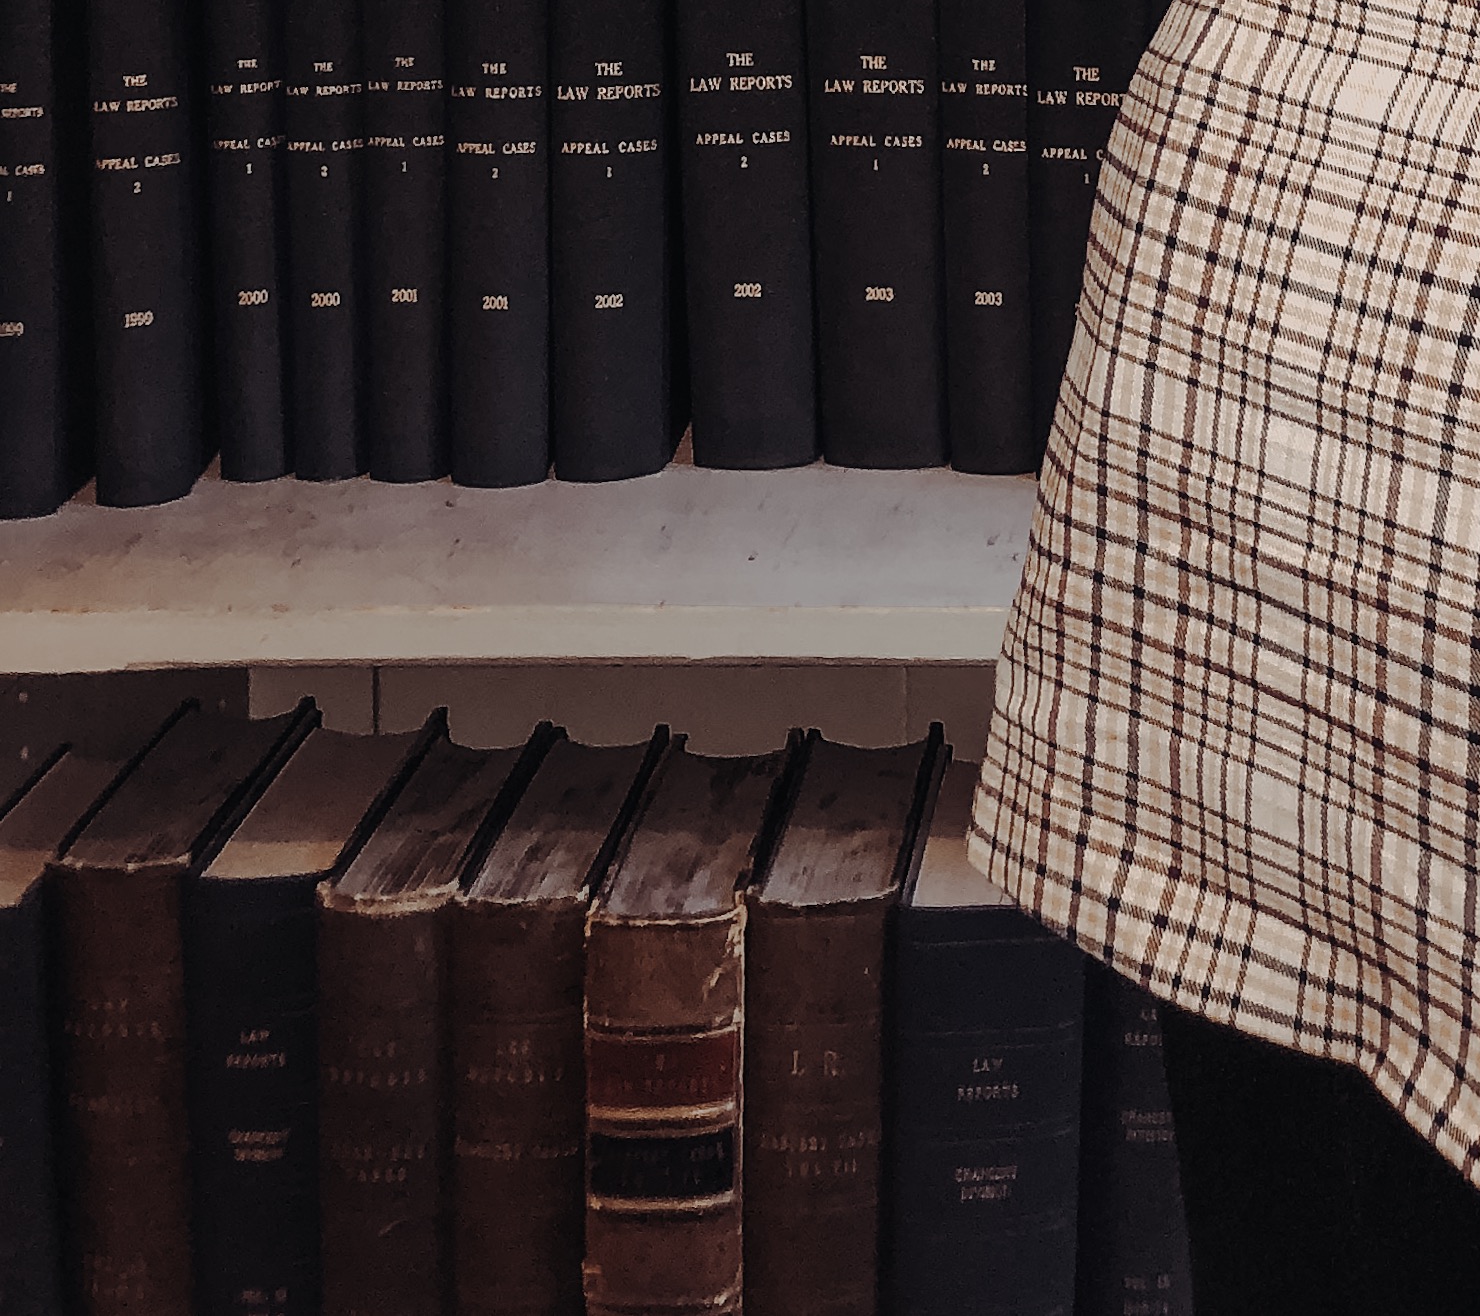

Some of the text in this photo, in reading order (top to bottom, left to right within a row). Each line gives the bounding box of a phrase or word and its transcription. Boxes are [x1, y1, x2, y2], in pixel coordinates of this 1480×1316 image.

[727, 53, 754, 66] THE
[860, 56, 886, 70] THE
[483, 63, 507, 74] THE
[595, 63, 623, 76] THE
[1073, 67, 1099, 81] THE
[690, 75, 793, 92] LAW REPORTS
[825, 79, 925, 94] LAW REPORTS
[557, 84, 661, 101] LAW REPORTS
[696, 131, 791, 145] APPEAL CASES
[830, 135, 922, 148] APPEAL CASES
[561, 140, 657, 155] APPEAL CASES
[741, 157, 748, 168] 2
[873, 160, 878, 170] 1
[492, 168, 498, 178] 2
[392, 289, 417, 303] 2001
[734, 284, 761, 298] 2002
[865, 287, 894, 302] 2003
[239, 291, 268, 306] 2000
[482, 296, 508, 311] 2001
[595, 295, 623, 309] 2002
[975, 292, 1002, 306] 2003
[124, 312, 154, 327] 1999
